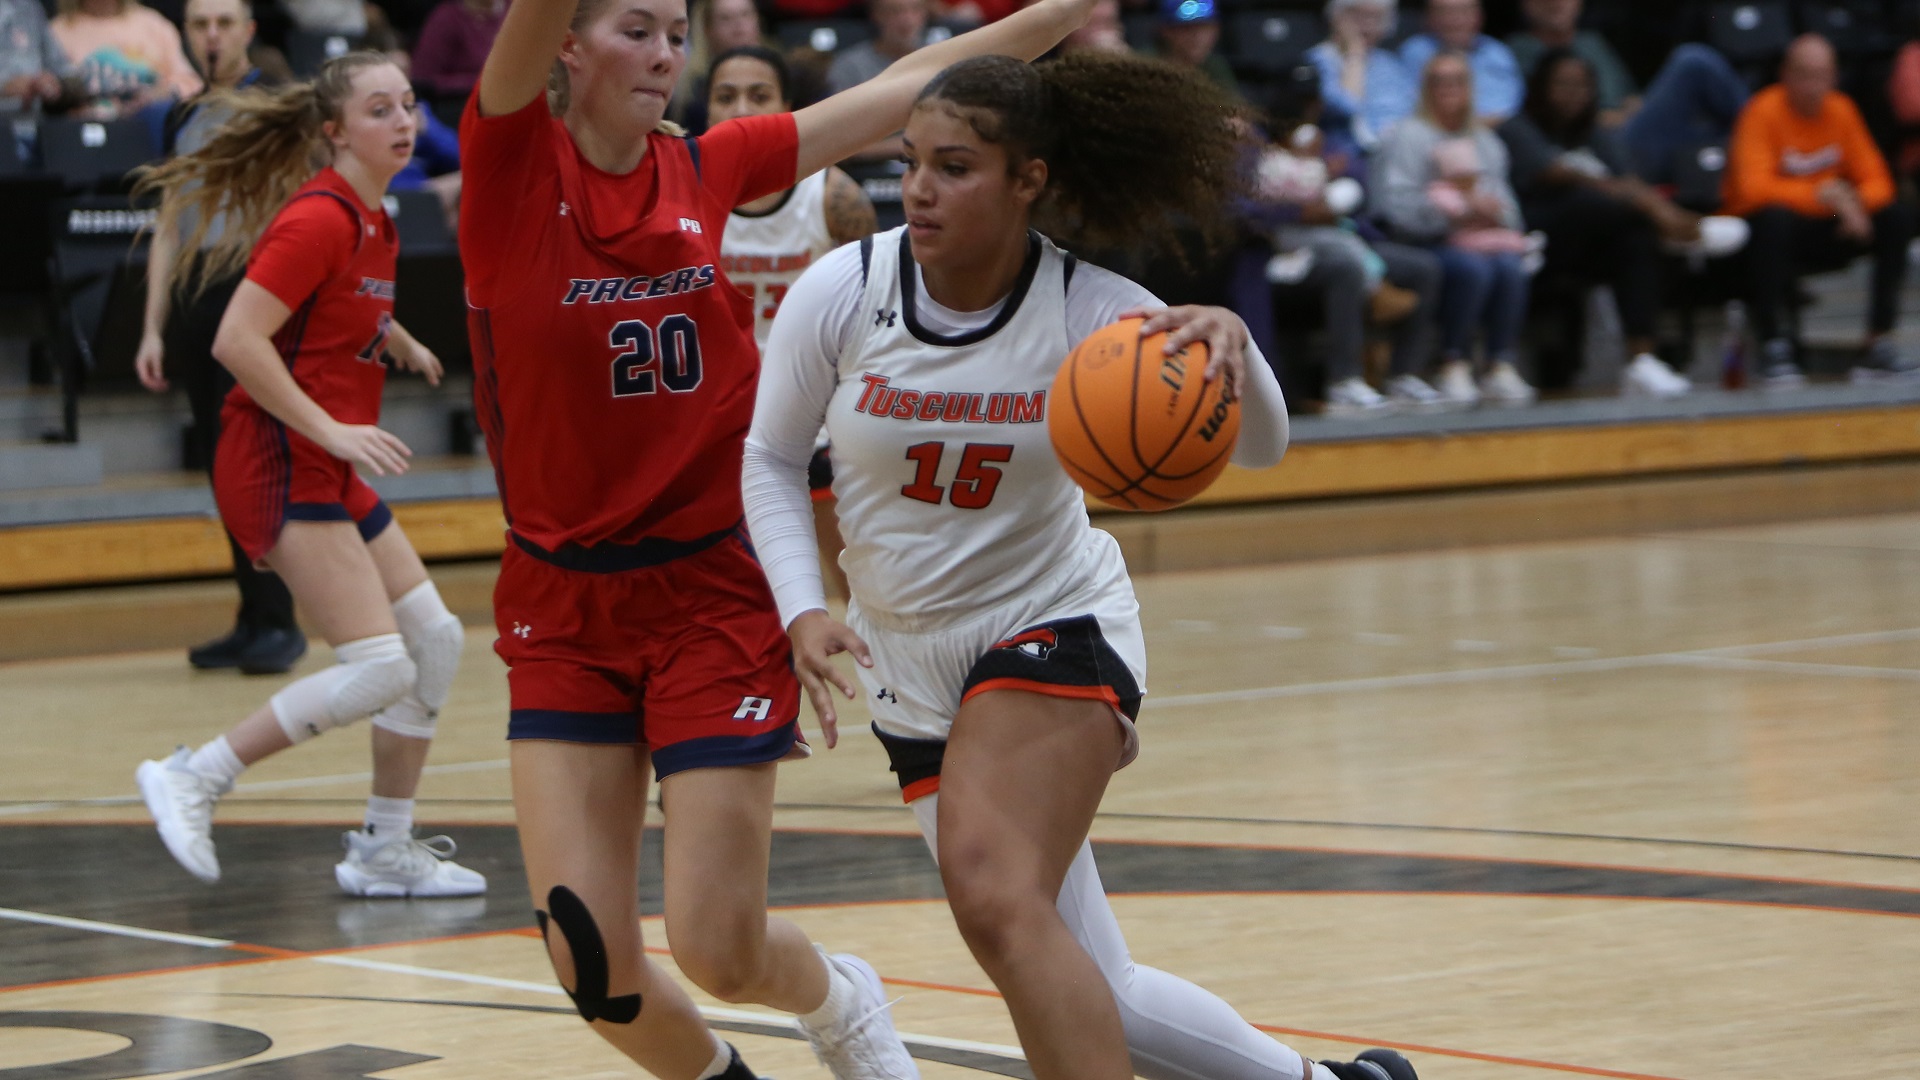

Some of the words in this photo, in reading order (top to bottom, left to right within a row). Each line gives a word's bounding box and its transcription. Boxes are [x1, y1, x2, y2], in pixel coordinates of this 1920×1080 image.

[679, 217, 703, 234] PB
[561, 264, 715, 305] PACERS
[609, 313, 704, 398] 20
[855, 371, 1046, 423] TUSCULUM
[901, 441, 1014, 510] 15
[732, 696, 773, 721] A
